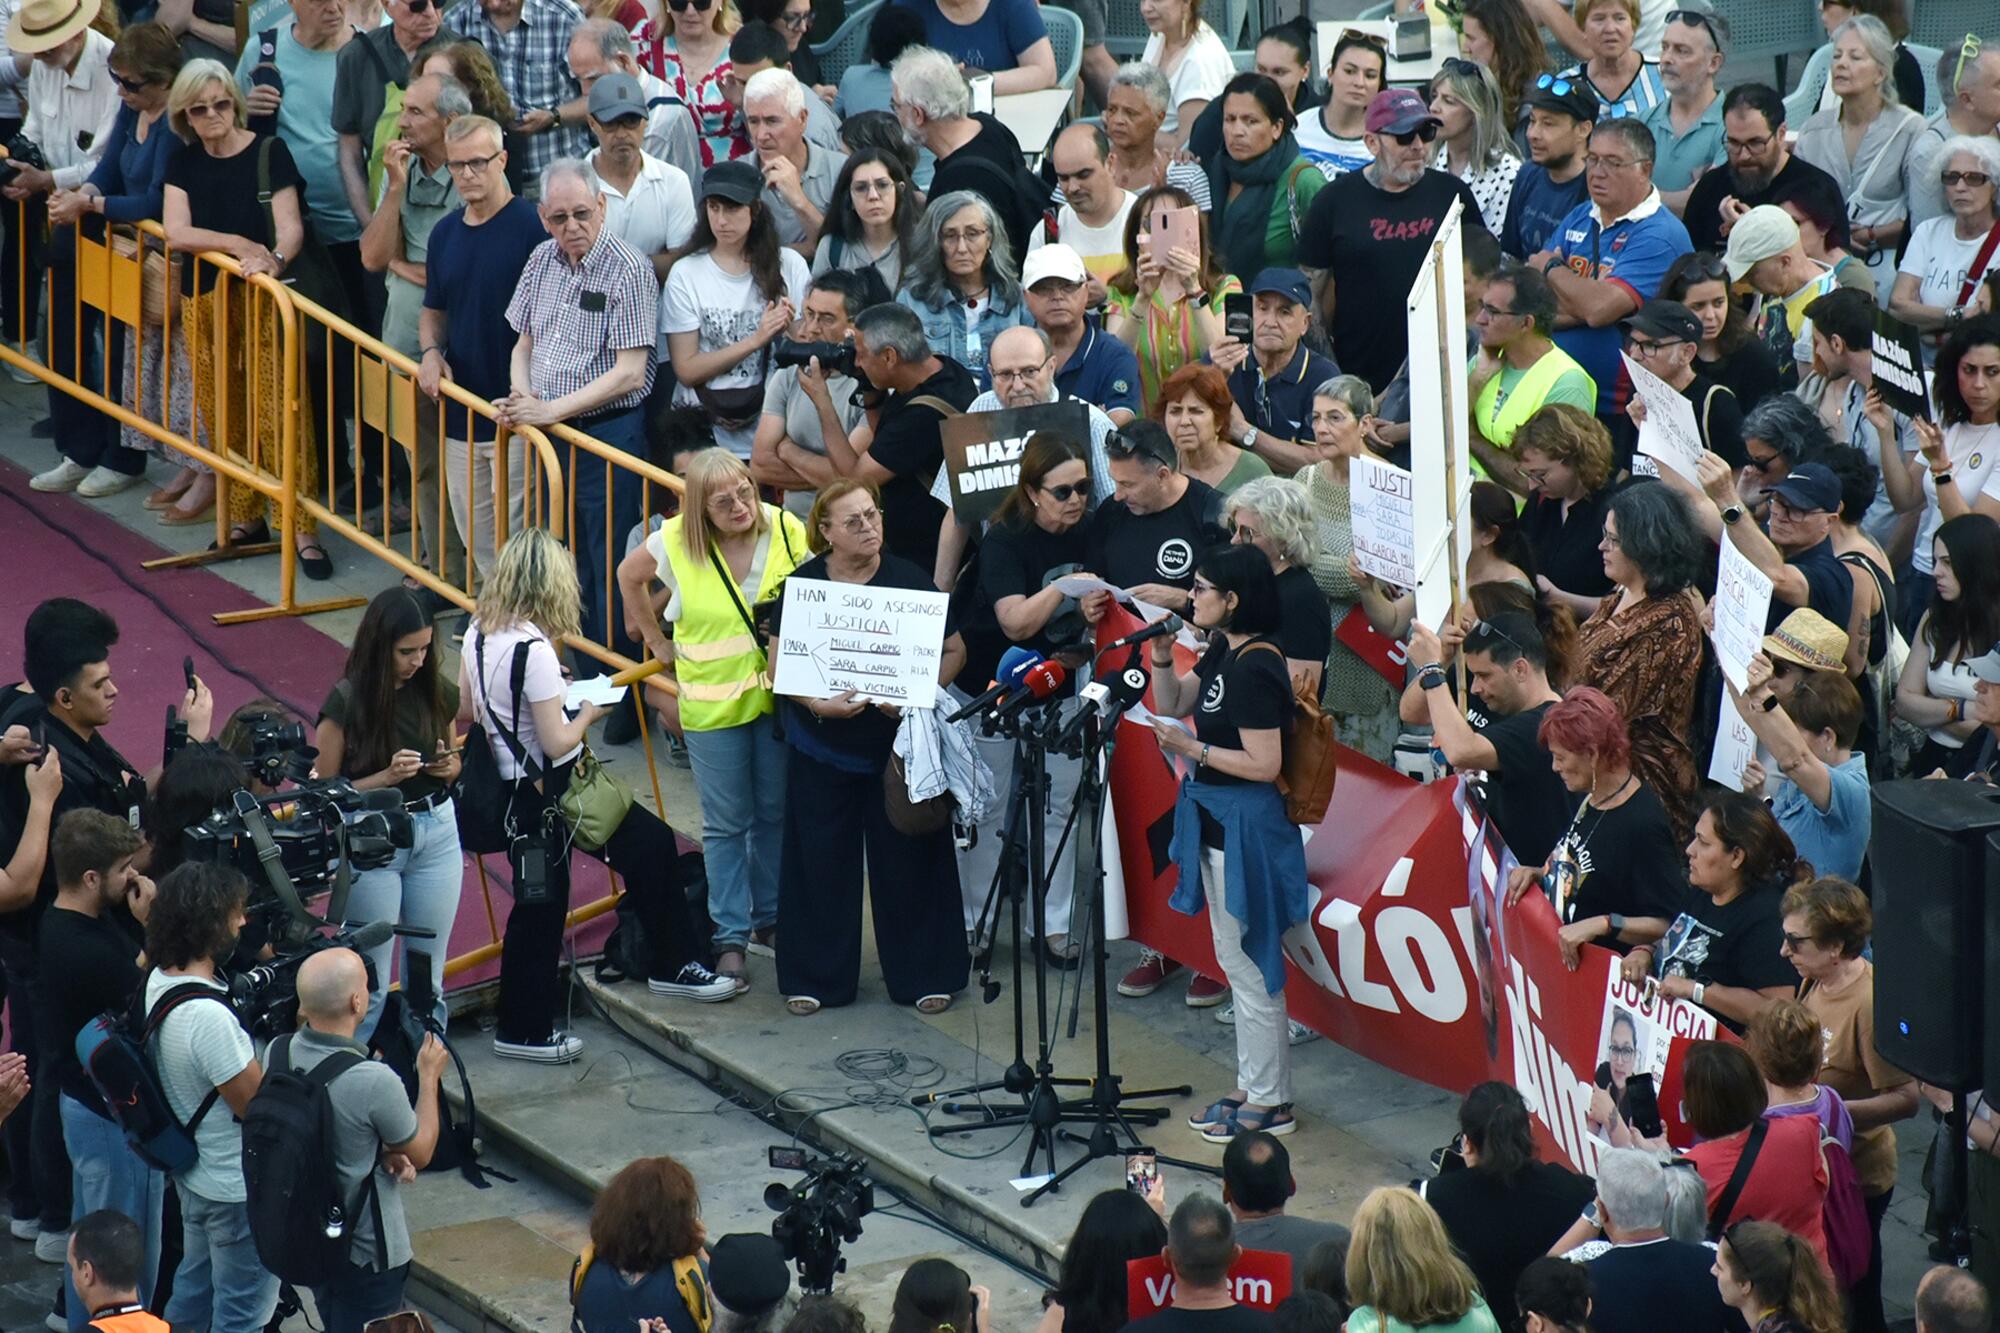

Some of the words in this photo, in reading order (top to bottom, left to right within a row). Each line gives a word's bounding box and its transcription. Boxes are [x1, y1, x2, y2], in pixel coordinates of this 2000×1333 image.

[965, 430, 1036, 467] MAZ
[797, 588, 826, 602] HAN
[841, 594, 873, 611] SIDO
[884, 600, 944, 616] ASESINOS
[783, 638, 809, 653] PARA
[869, 642, 901, 655] CARPIO
[830, 656, 857, 670] SARA
[865, 664, 897, 675] CARPIO
[864, 682, 908, 695] VICTIMAS
[1281, 850, 1479, 1023] azó
